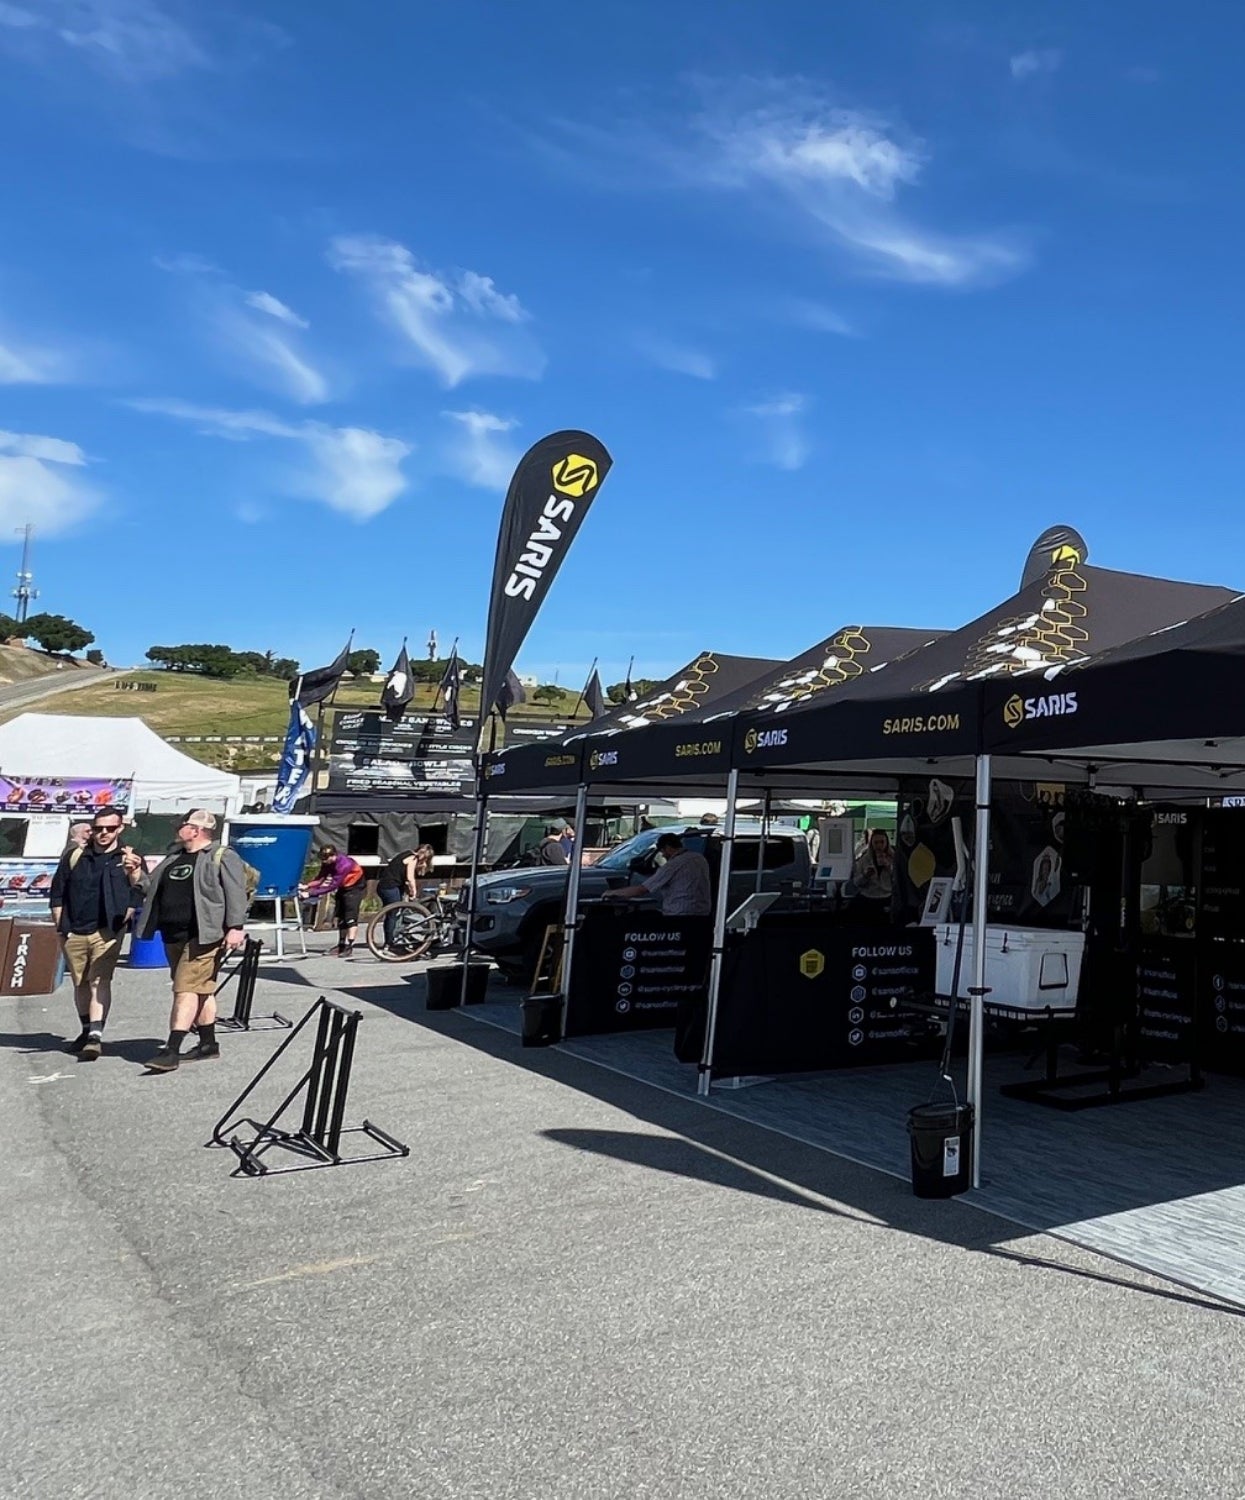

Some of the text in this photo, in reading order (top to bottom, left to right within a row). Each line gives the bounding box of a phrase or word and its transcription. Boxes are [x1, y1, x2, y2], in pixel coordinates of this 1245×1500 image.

[504, 494, 575, 601] SARIS
[1024, 692, 1078, 719] SARIS
[883, 713, 960, 734] SARIS.COM
[756, 729, 788, 748] SARIS
[675, 741, 721, 757] SARIS.COM
[625, 932, 682, 942] FOLLOW US
[10, 933, 32, 988] TRASH
[852, 946, 912, 958] FOLLOW US
